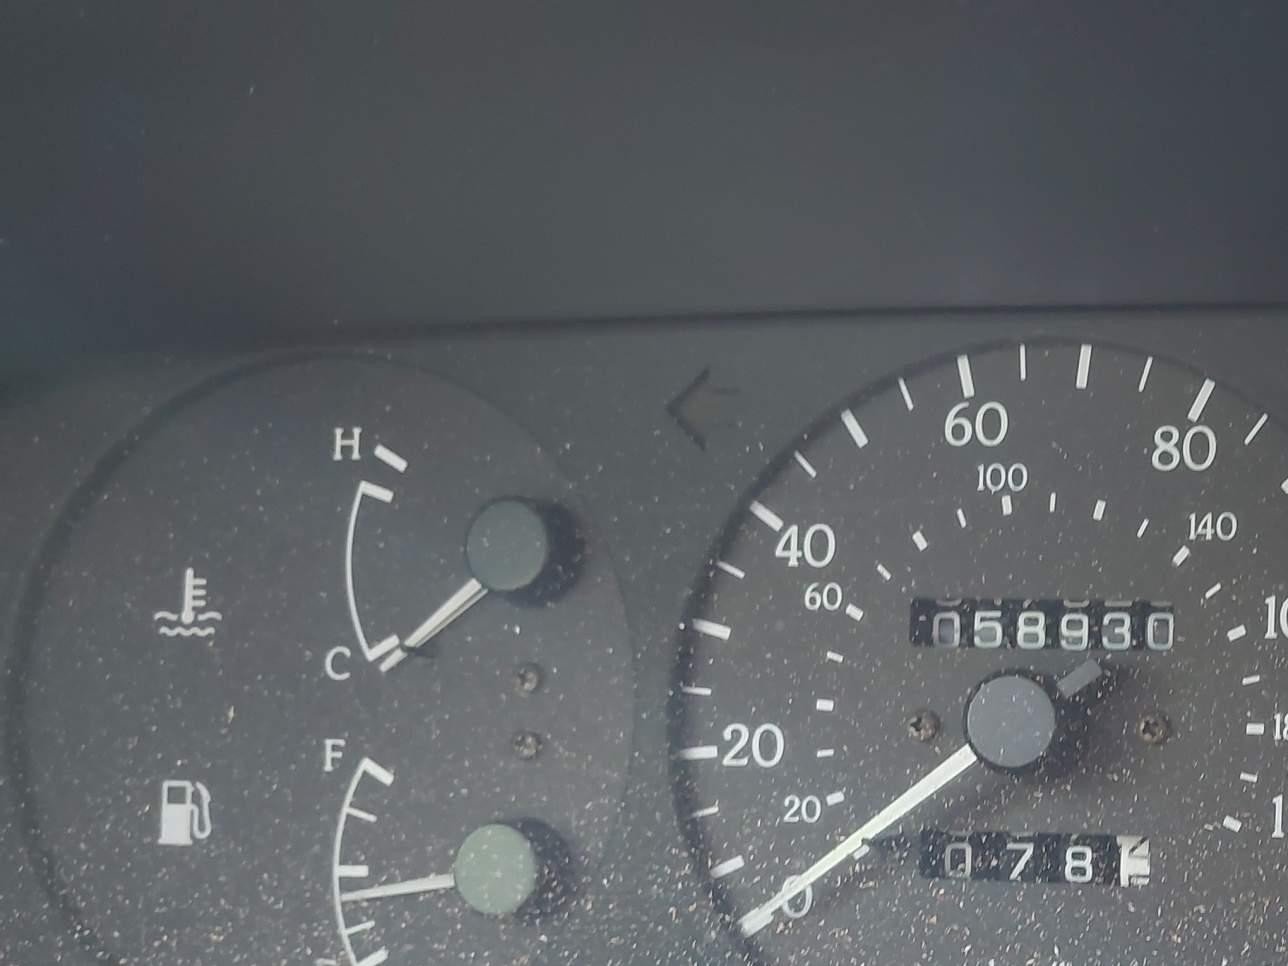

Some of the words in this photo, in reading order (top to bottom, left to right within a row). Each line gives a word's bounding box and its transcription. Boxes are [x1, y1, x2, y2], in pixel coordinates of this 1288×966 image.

[944, 403, 1008, 447] 60
[333, 429, 361, 461] H
[1151, 426, 1217, 471] 80
[976, 464, 1027, 491] 100
[1188, 513, 1238, 541] 140
[775, 524, 836, 567] 40
[804, 583, 842, 610] 60
[326, 649, 350, 680] C
[324, 740, 345, 771] F
[721, 724, 784, 767] 20
[783, 794, 822, 823] 20
[782, 875, 813, 918] 0
